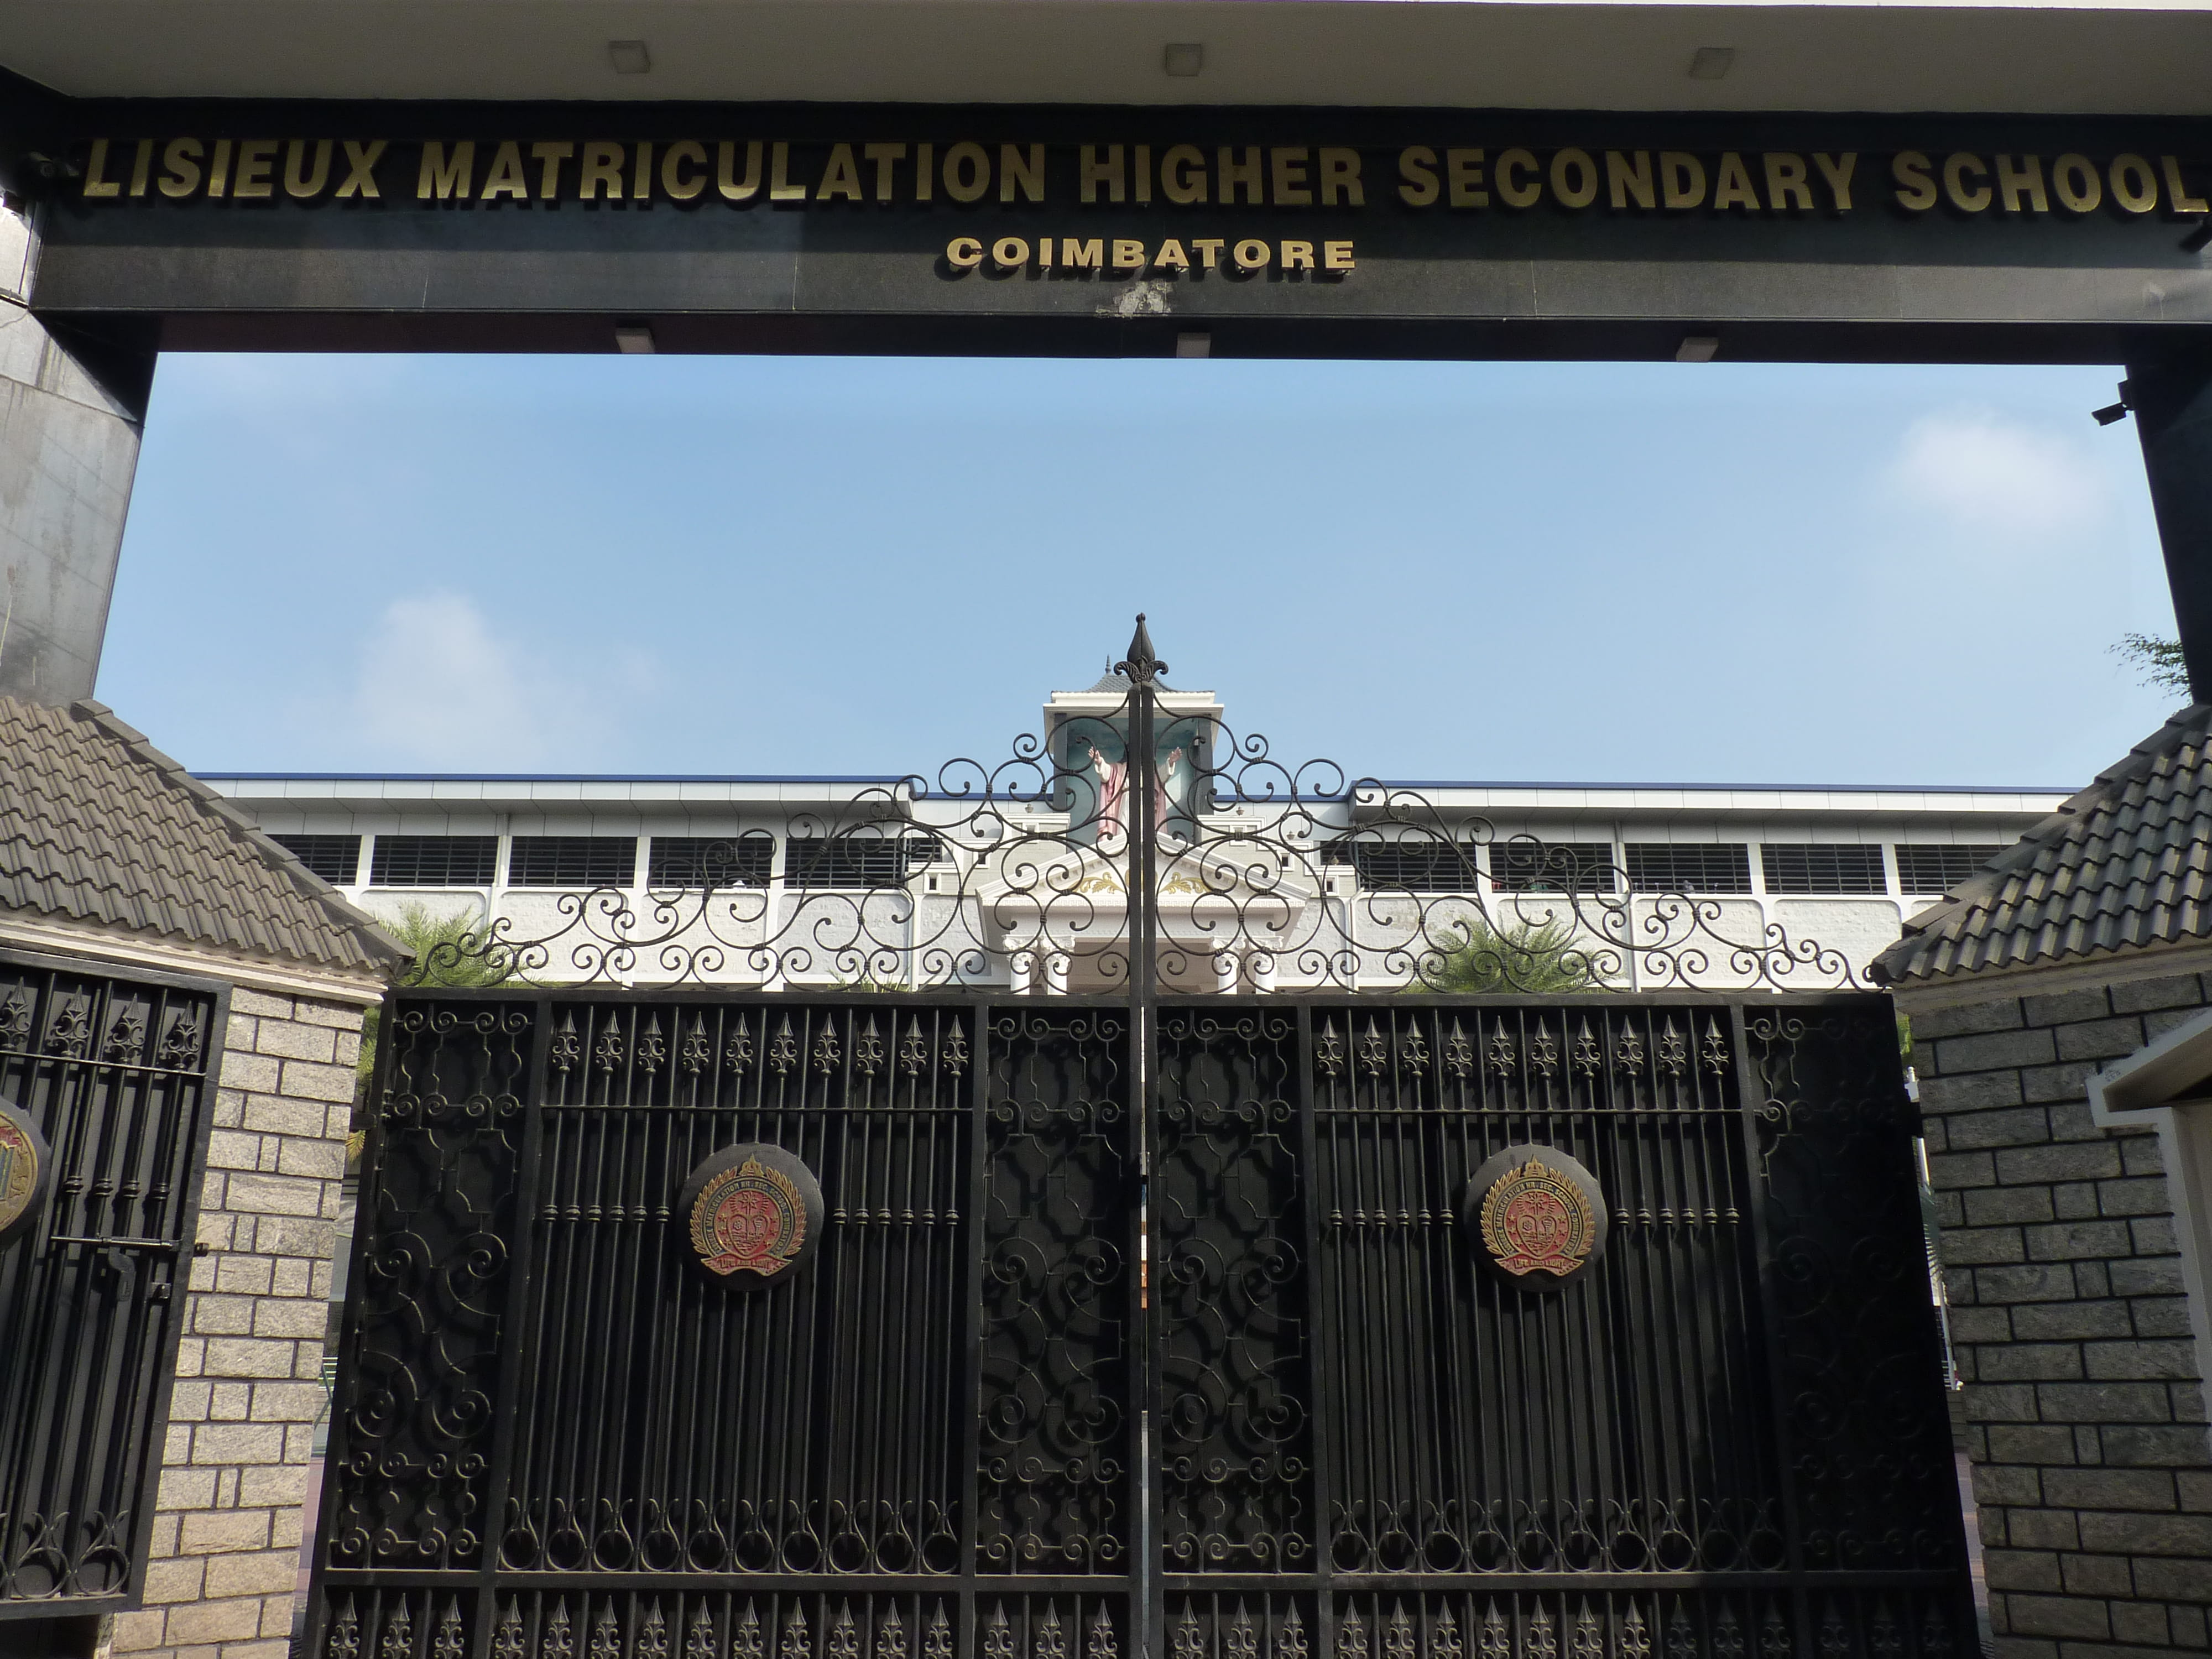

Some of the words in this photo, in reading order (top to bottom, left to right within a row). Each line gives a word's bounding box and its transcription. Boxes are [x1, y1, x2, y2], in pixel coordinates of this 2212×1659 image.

[83, 137, 390, 199] LISIEUX
[416, 139, 1045, 205] MATRICULATION
[1080, 143, 1365, 207] HIGHER
[1398, 145, 1858, 212] SECONDARY
[1891, 150, 2209, 213] SCHOOL
[946, 237, 1356, 269] COIMBATORE
